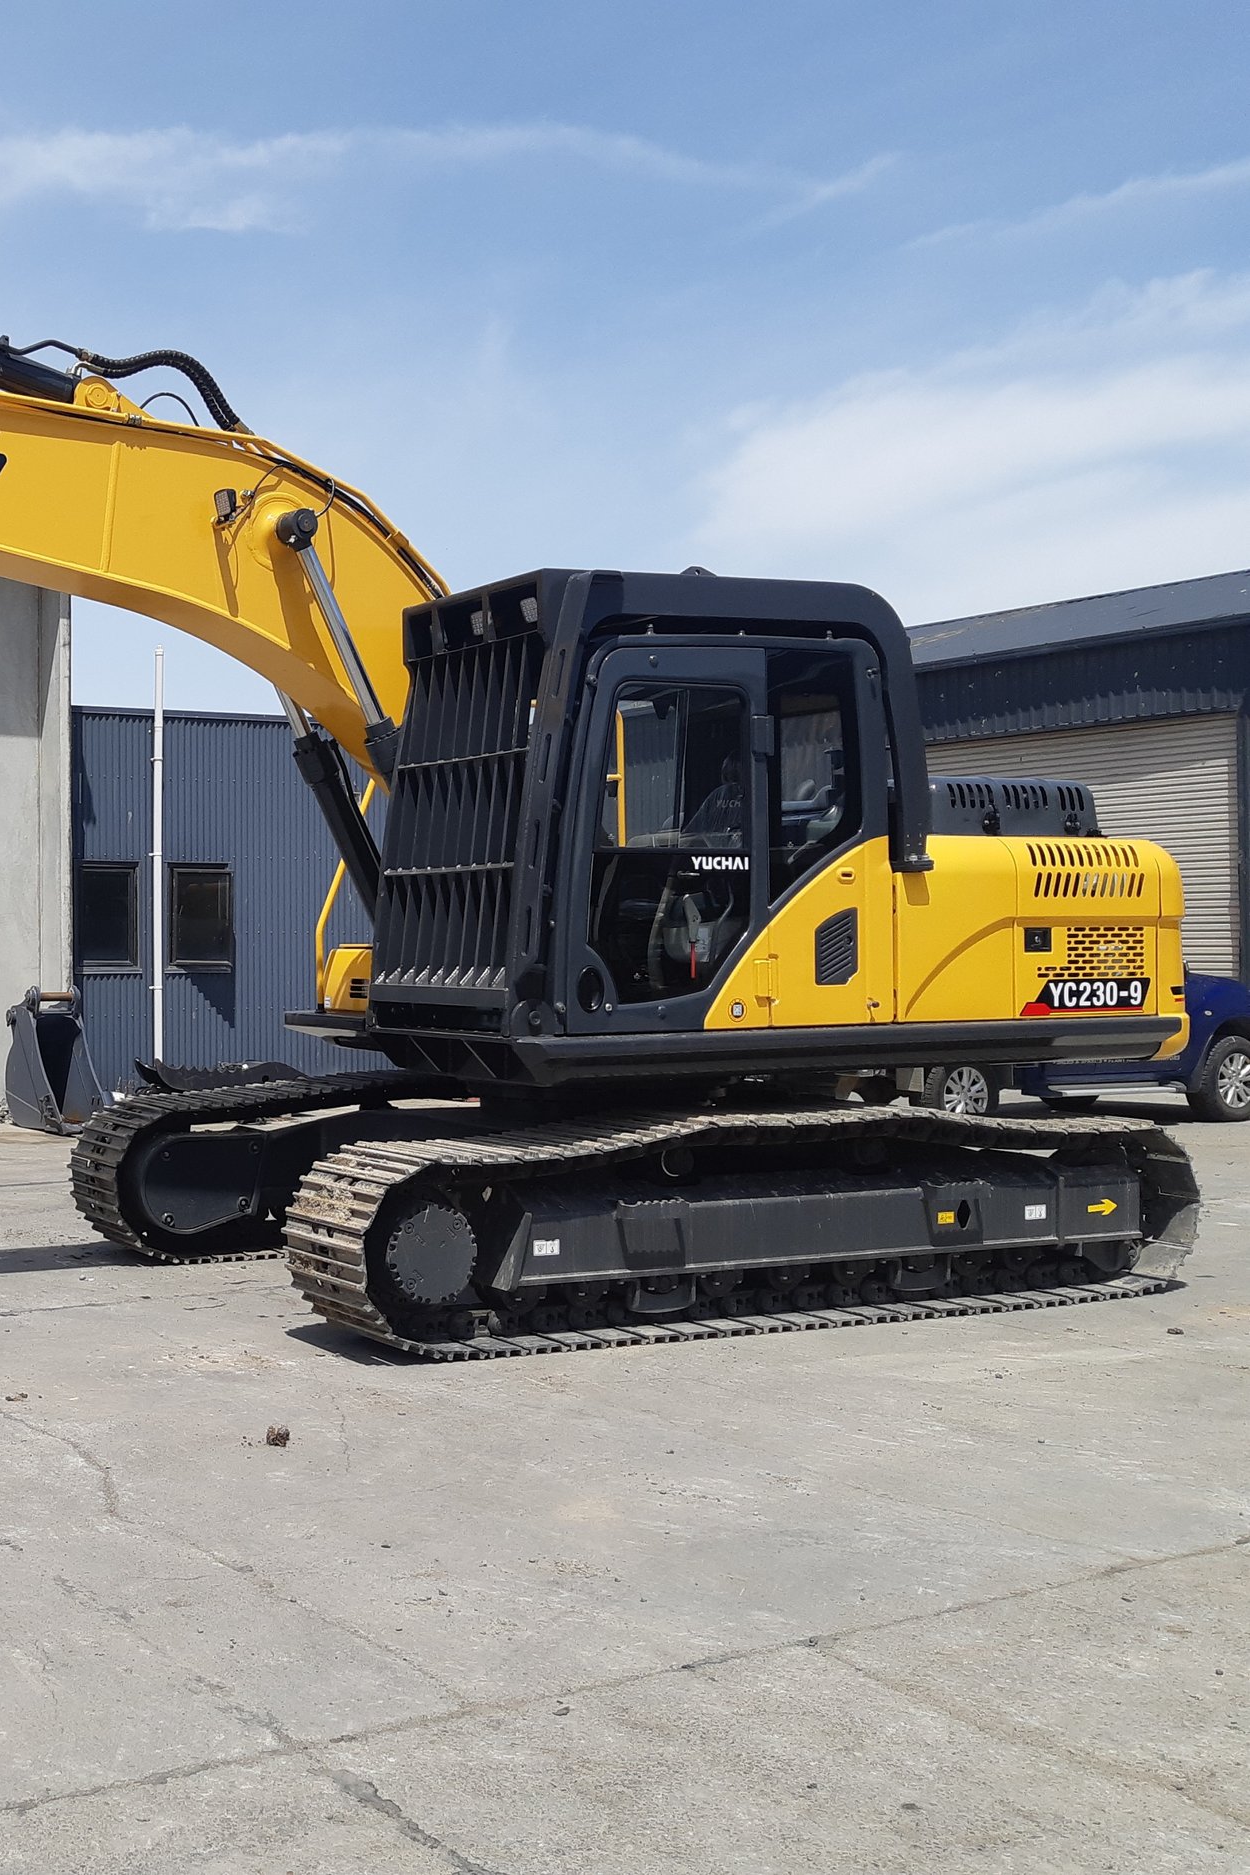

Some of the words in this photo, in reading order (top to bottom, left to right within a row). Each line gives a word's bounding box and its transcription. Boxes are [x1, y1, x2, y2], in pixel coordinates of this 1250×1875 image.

[716, 799, 741, 808] YUCH
[691, 856, 749, 870] YUCHAI
[1049, 980, 1143, 1008] YC230-9
